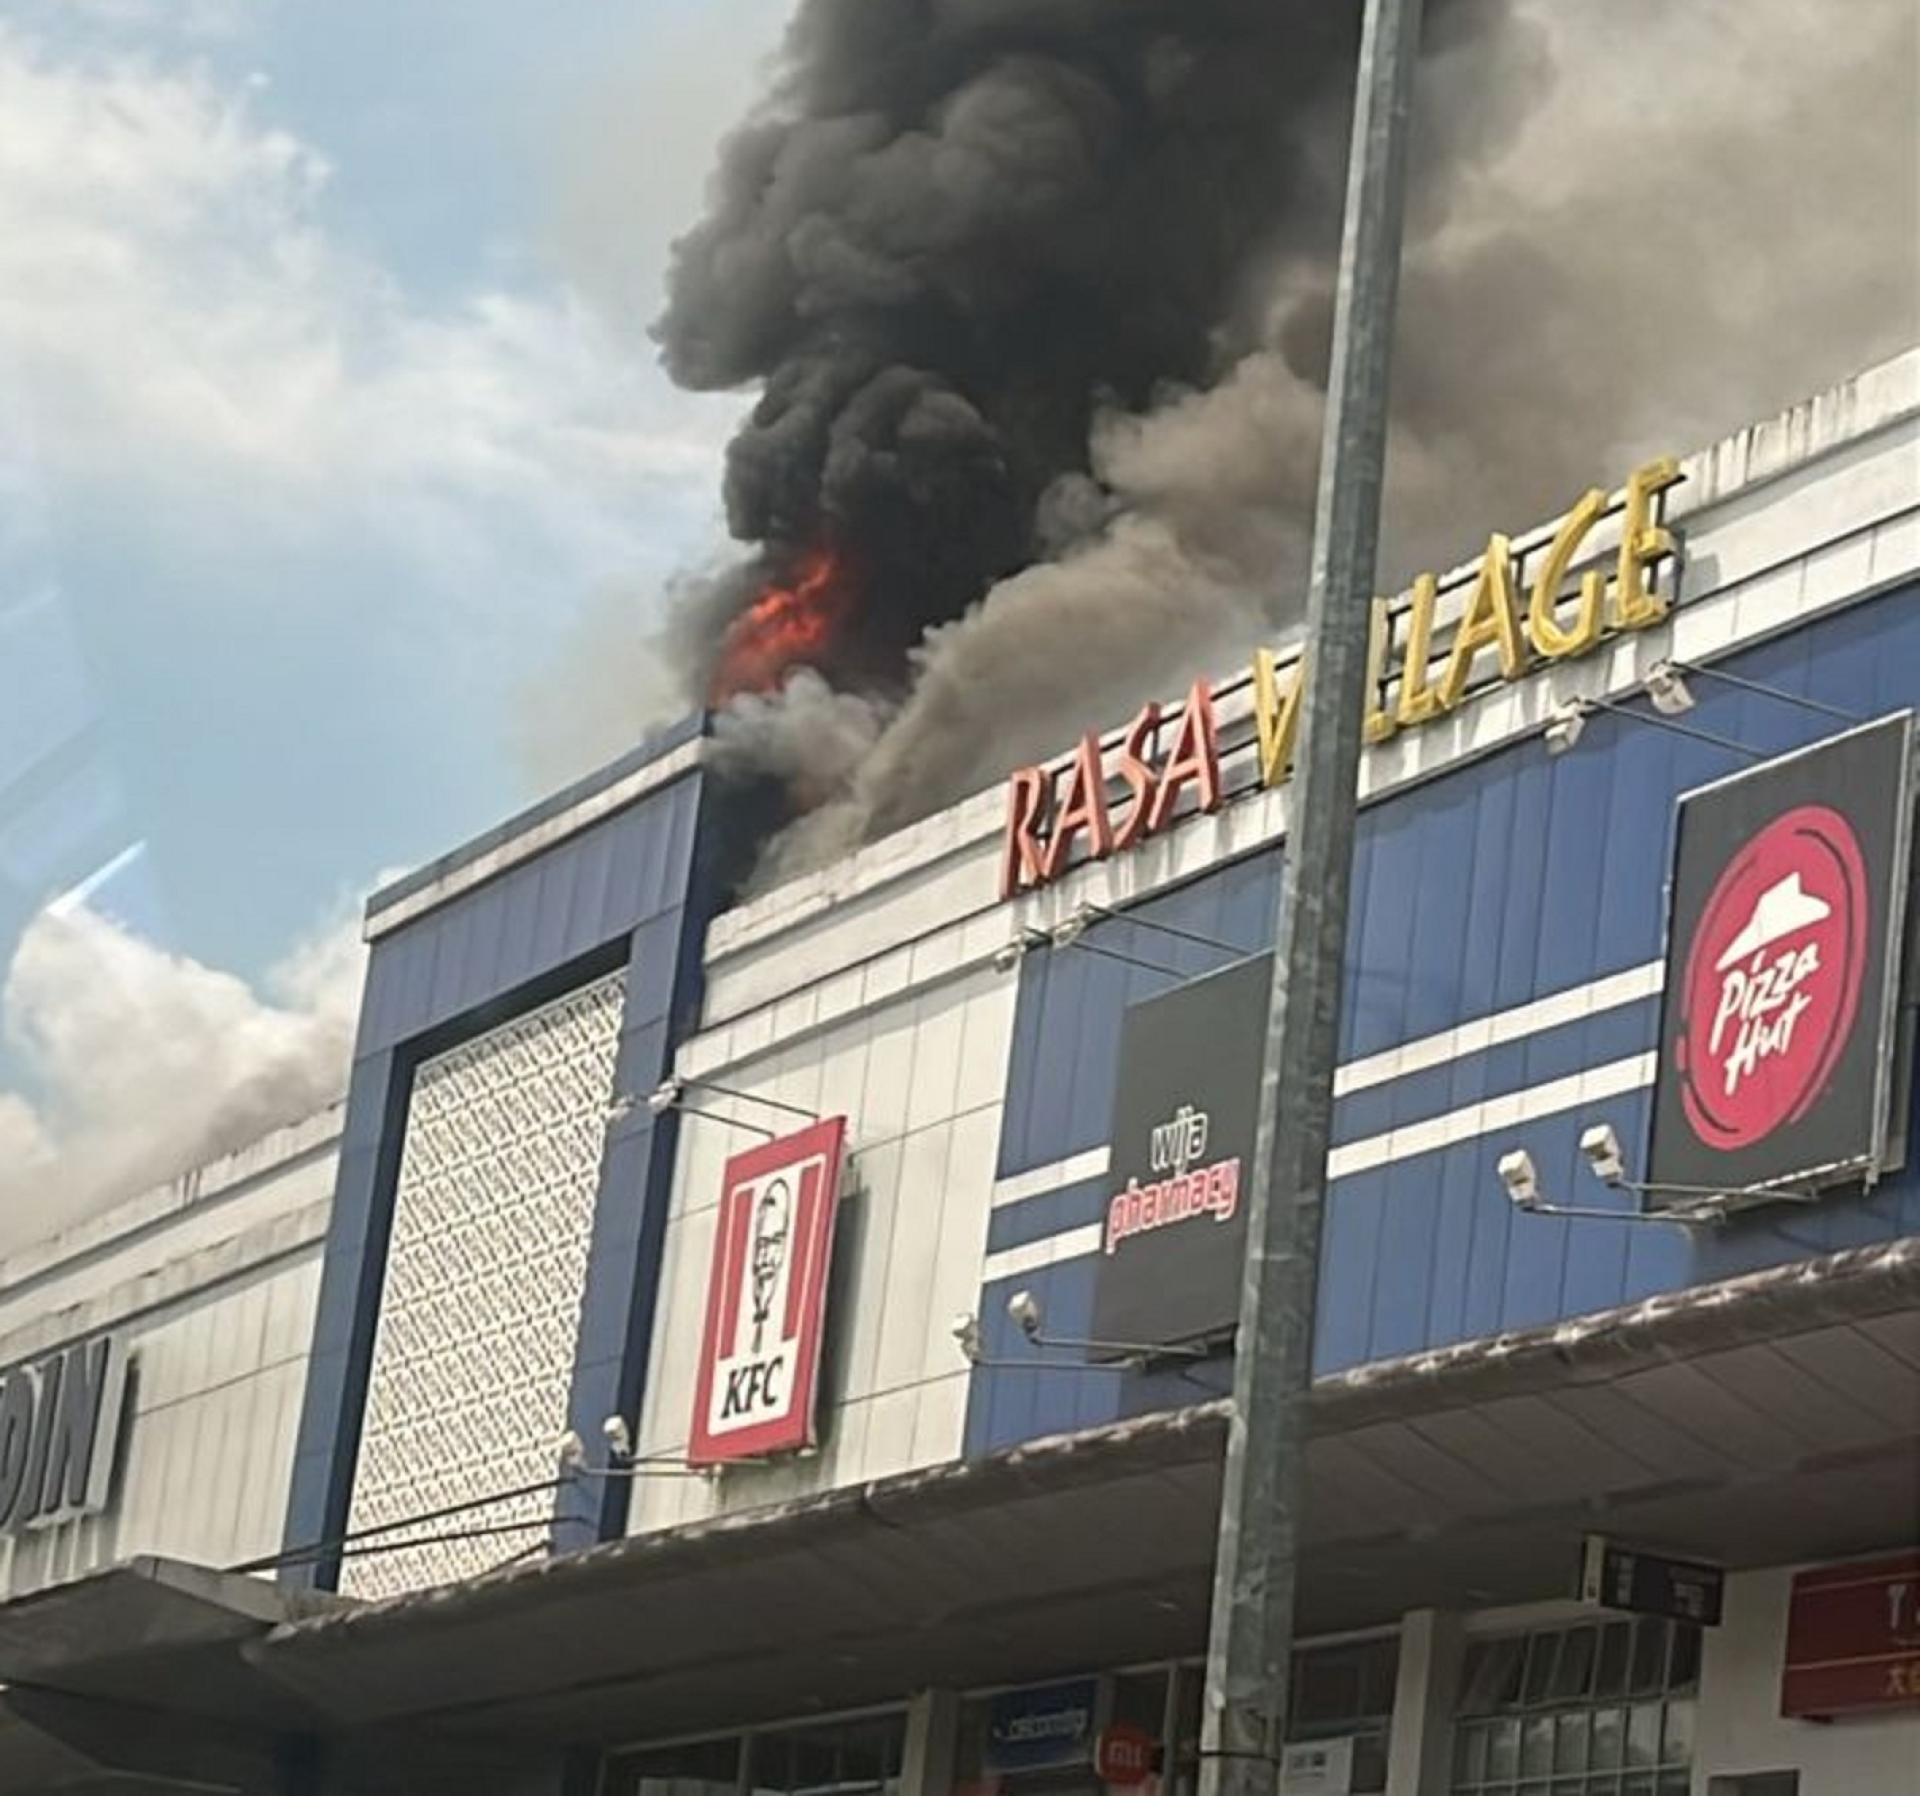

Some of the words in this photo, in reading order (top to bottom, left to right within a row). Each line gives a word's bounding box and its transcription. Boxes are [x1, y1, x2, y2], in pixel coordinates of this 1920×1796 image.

[1001, 677, 1222, 898] RASA
[1253, 456, 1680, 786] VLLAGE
[1709, 942, 1820, 1056] Pizza
[1724, 994, 1812, 1096] Hut
[1105, 1157, 1241, 1255] pharmacy
[720, 1355, 784, 1420] KFC
